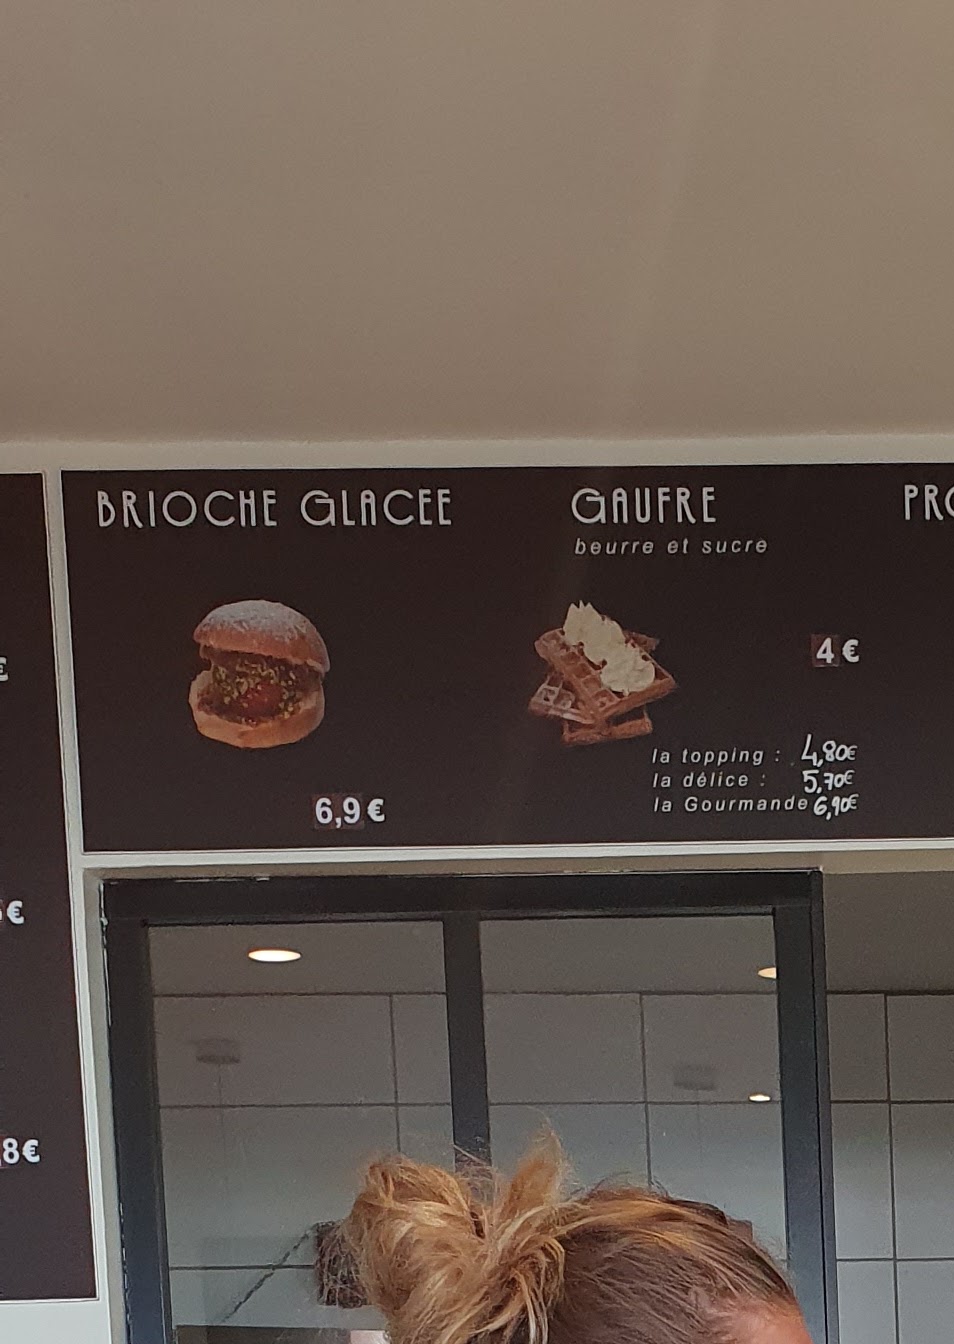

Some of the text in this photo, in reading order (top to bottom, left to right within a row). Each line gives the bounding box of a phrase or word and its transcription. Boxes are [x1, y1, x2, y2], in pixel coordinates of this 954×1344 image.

[97, 488, 452, 529] BRIOCHE GLACEE
[571, 486, 716, 524] GAUFRE
[574, 537, 767, 555] beurre et sucre
[652, 748, 670, 764] la
[682, 747, 764, 767] topping
[652, 772, 671, 788] la
[683, 771, 749, 788] délice
[653, 796, 672, 812] la
[684, 795, 808, 812] Gourmande
